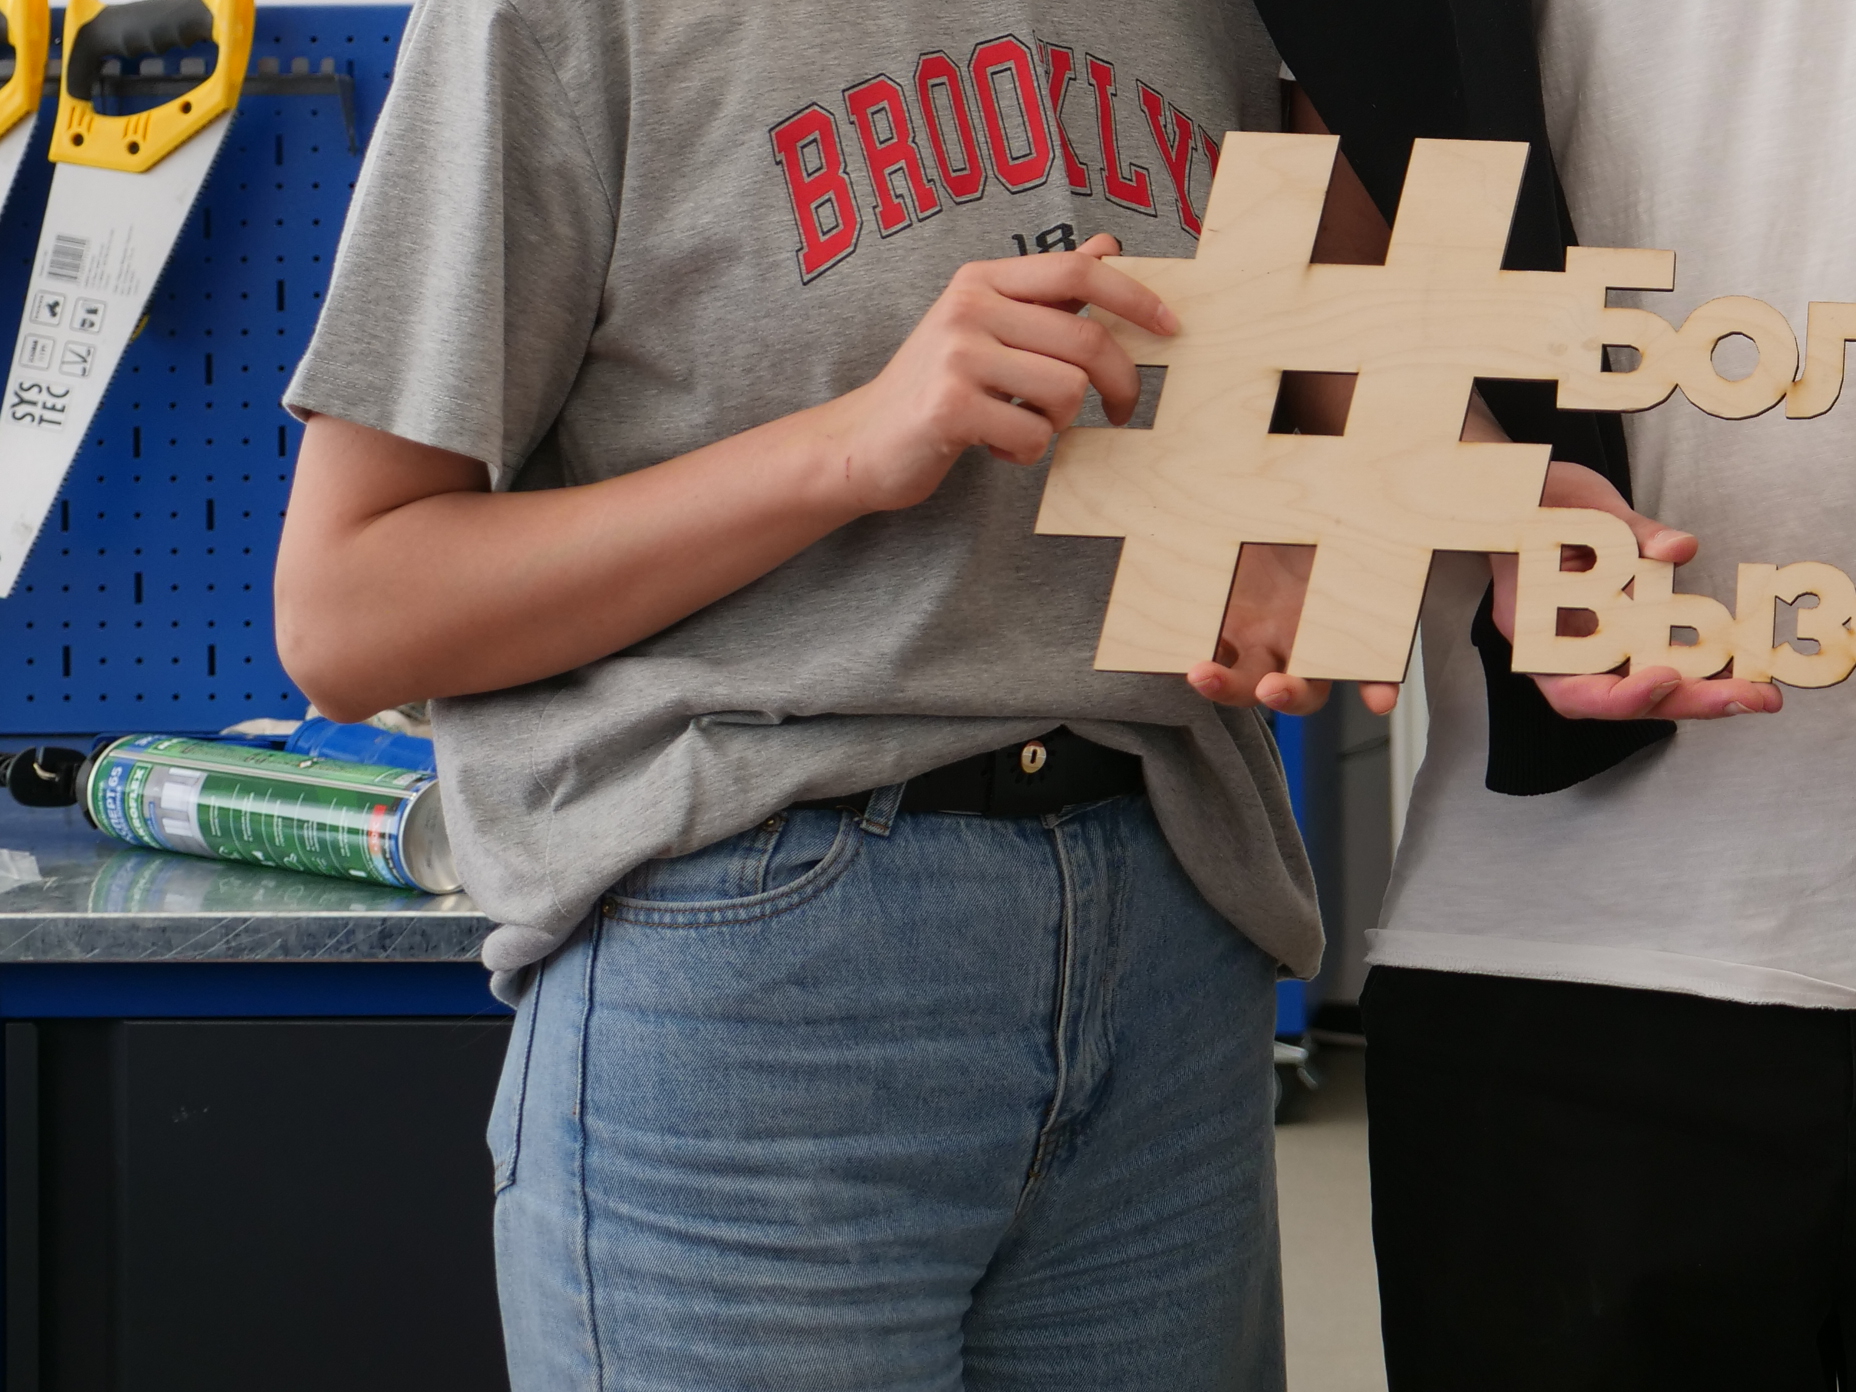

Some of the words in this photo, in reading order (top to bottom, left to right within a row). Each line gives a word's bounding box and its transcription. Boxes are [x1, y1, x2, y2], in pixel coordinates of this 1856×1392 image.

[769, 33, 1220, 286] BROOKLY
[11, 381, 42, 423] SYS
[38, 385, 70, 426] TEC
